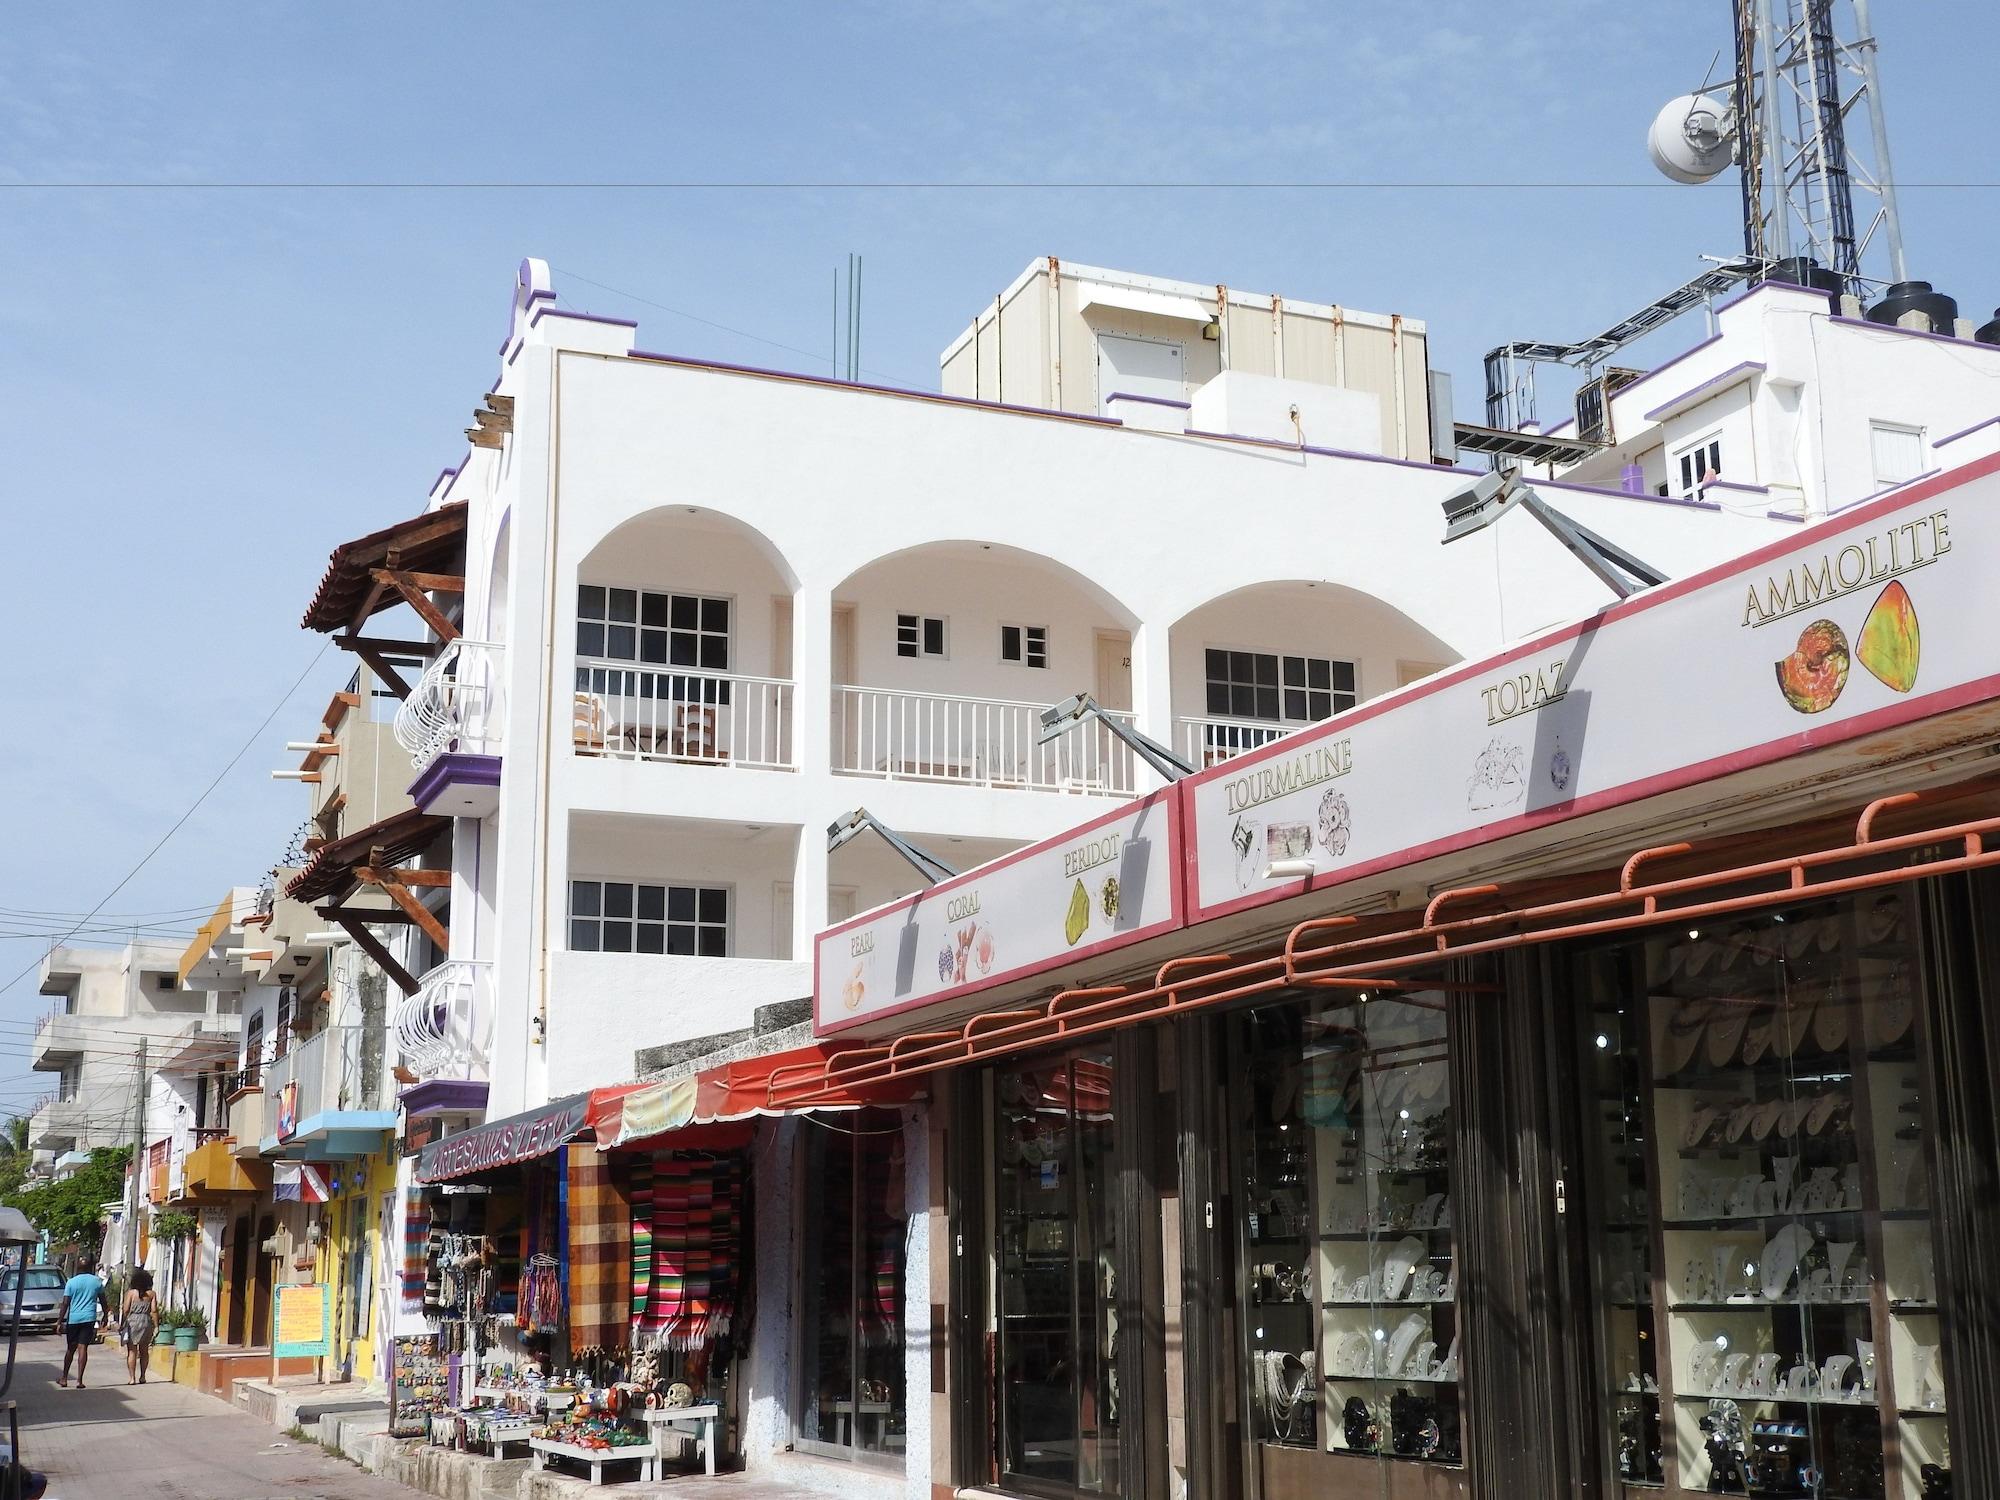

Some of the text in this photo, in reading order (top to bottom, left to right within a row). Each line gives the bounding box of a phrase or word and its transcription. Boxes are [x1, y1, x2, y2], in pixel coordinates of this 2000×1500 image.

[1742, 509, 1952, 627] AMMOLITE
[1481, 659, 1568, 721] TOPAZ
[1224, 737, 1353, 812] TOURMALINE
[1063, 833, 1121, 876] PERIDOT
[946, 889, 982, 921] CORAL
[850, 929, 876, 954] PEARL
[429, 1123, 515, 1177] ARTESANIAS
